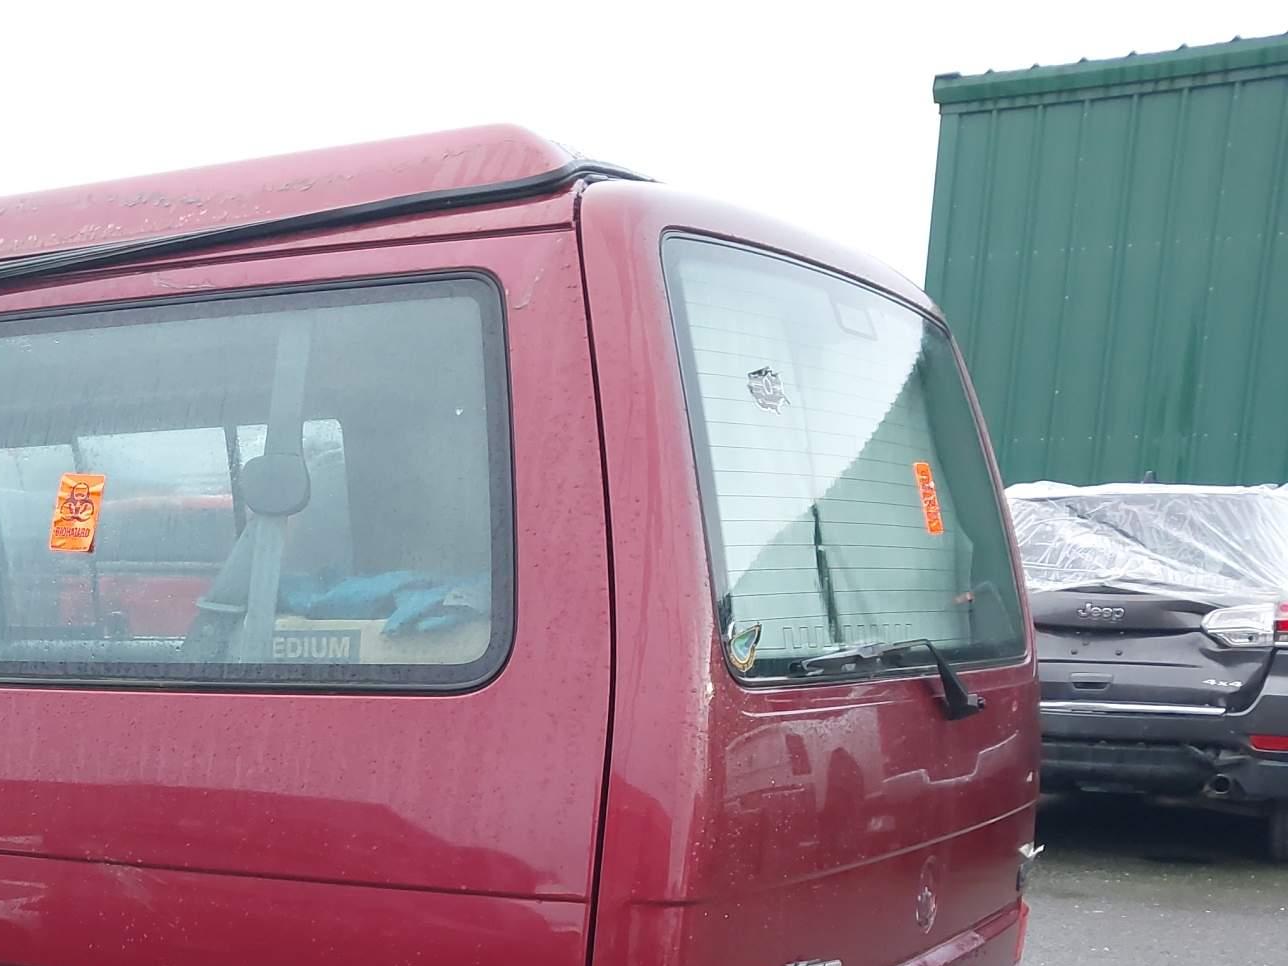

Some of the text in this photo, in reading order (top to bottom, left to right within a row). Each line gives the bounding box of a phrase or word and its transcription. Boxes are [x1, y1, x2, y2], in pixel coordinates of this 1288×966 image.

[1077, 602, 1125, 621] Jeep
[273, 636, 351, 658] EDIUM
[1201, 678, 1244, 688] 4x4
